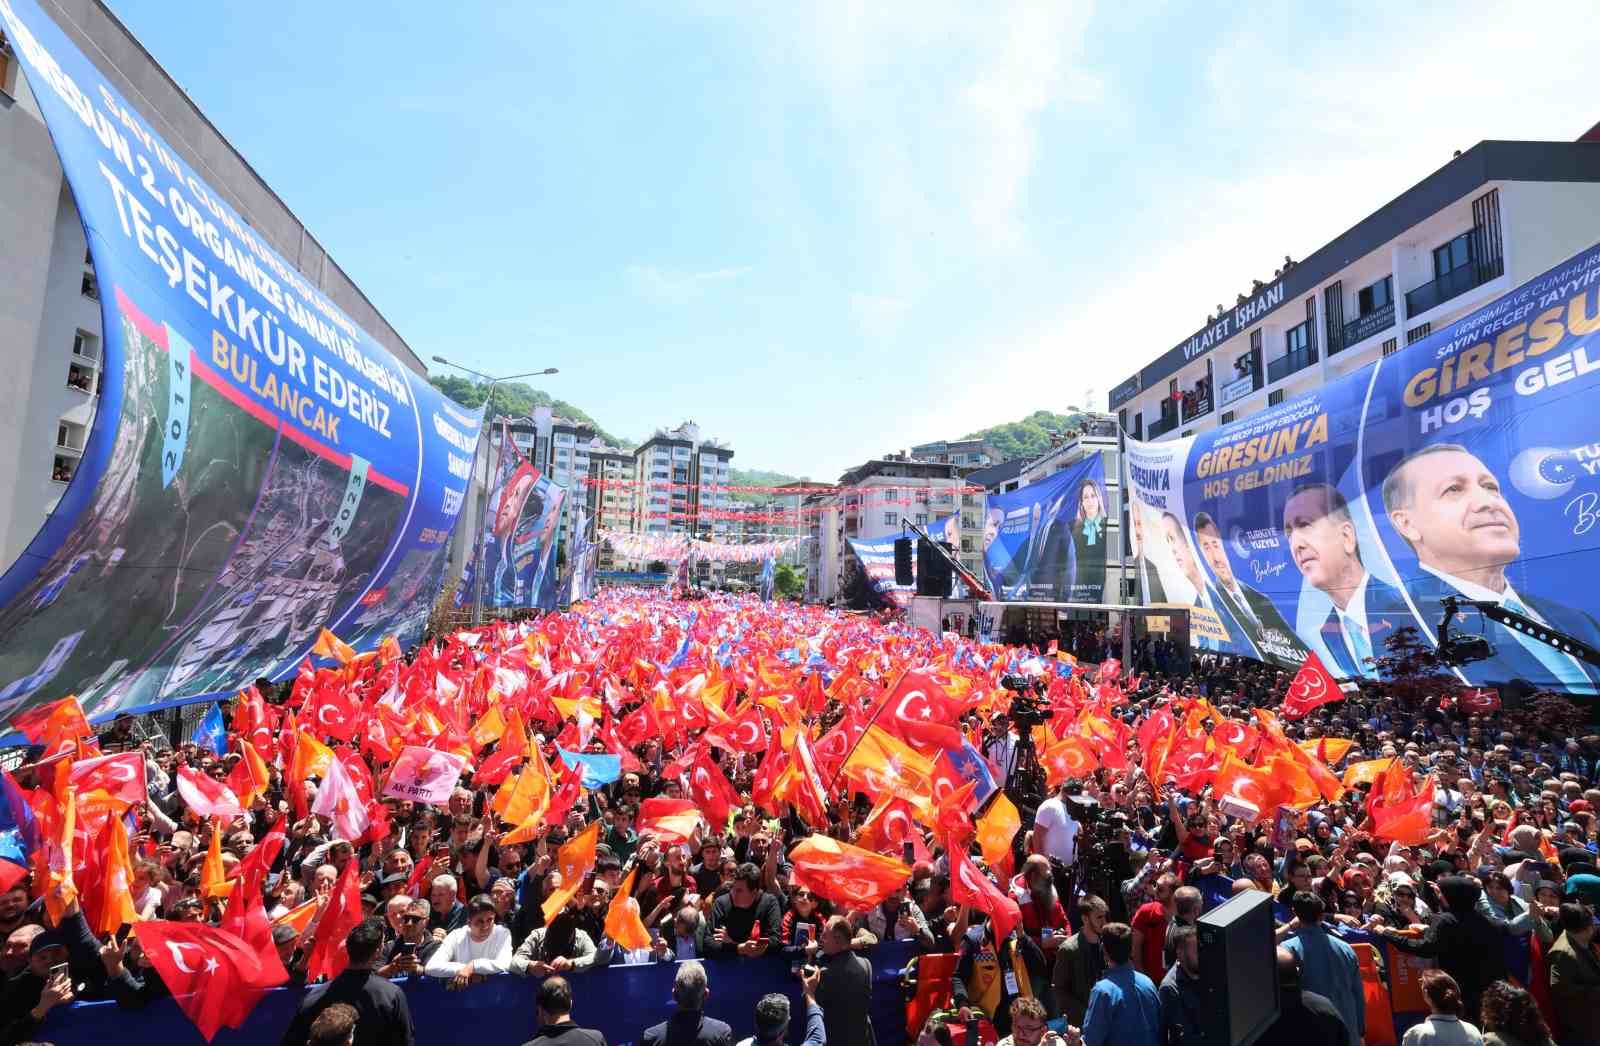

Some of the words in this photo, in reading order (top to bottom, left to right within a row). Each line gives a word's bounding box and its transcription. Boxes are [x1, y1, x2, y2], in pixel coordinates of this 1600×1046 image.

[98, 160, 308, 386] TEŞEKKÜR
[312, 355, 392, 440] EDERİZ
[169, 186, 285, 313] ORGANİZE
[284, 292, 343, 361] SANAYİ
[1183, 318, 1231, 361] VİLAYET
[1235, 281, 1285, 329] İŞHANI
[1435, 328, 1479, 360] SAYIN
[1482, 302, 1535, 337] RECEP
[165, 360, 184, 471] 2014
[211, 329, 342, 444] BULANCAK
[1420, 387, 1493, 434] HOŞ
[1514, 346, 1600, 396] GEL
[1196, 412, 1328, 479] GİRESUN'A
[332, 474, 362, 538] 2023
[391, 783, 406, 793] AK
[407, 786, 433, 799] PARTİ
